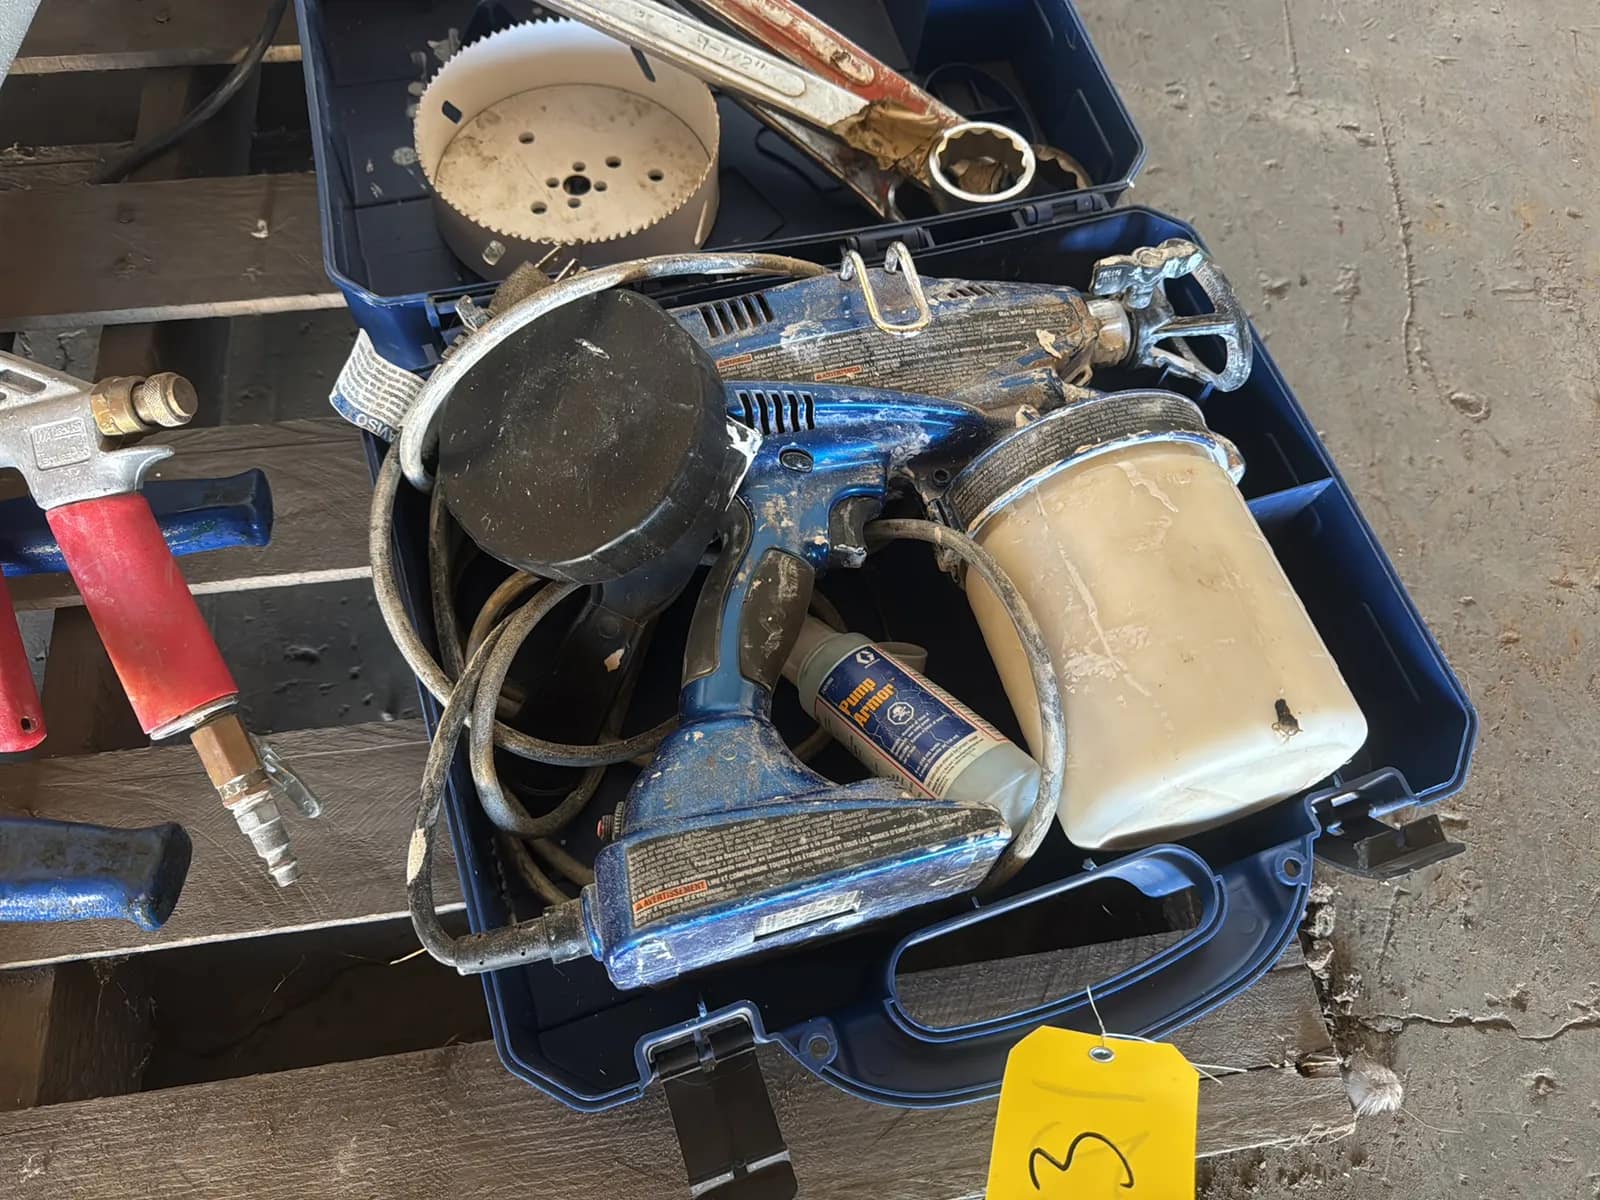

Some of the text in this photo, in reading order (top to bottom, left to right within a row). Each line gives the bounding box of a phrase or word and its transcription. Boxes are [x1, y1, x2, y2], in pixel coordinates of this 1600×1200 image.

[357, 413, 398, 442] AVISO
[838, 677, 877, 716] Pump
[854, 683, 896, 727] Armor
[643, 881, 706, 907] AVERTISSEMENT
